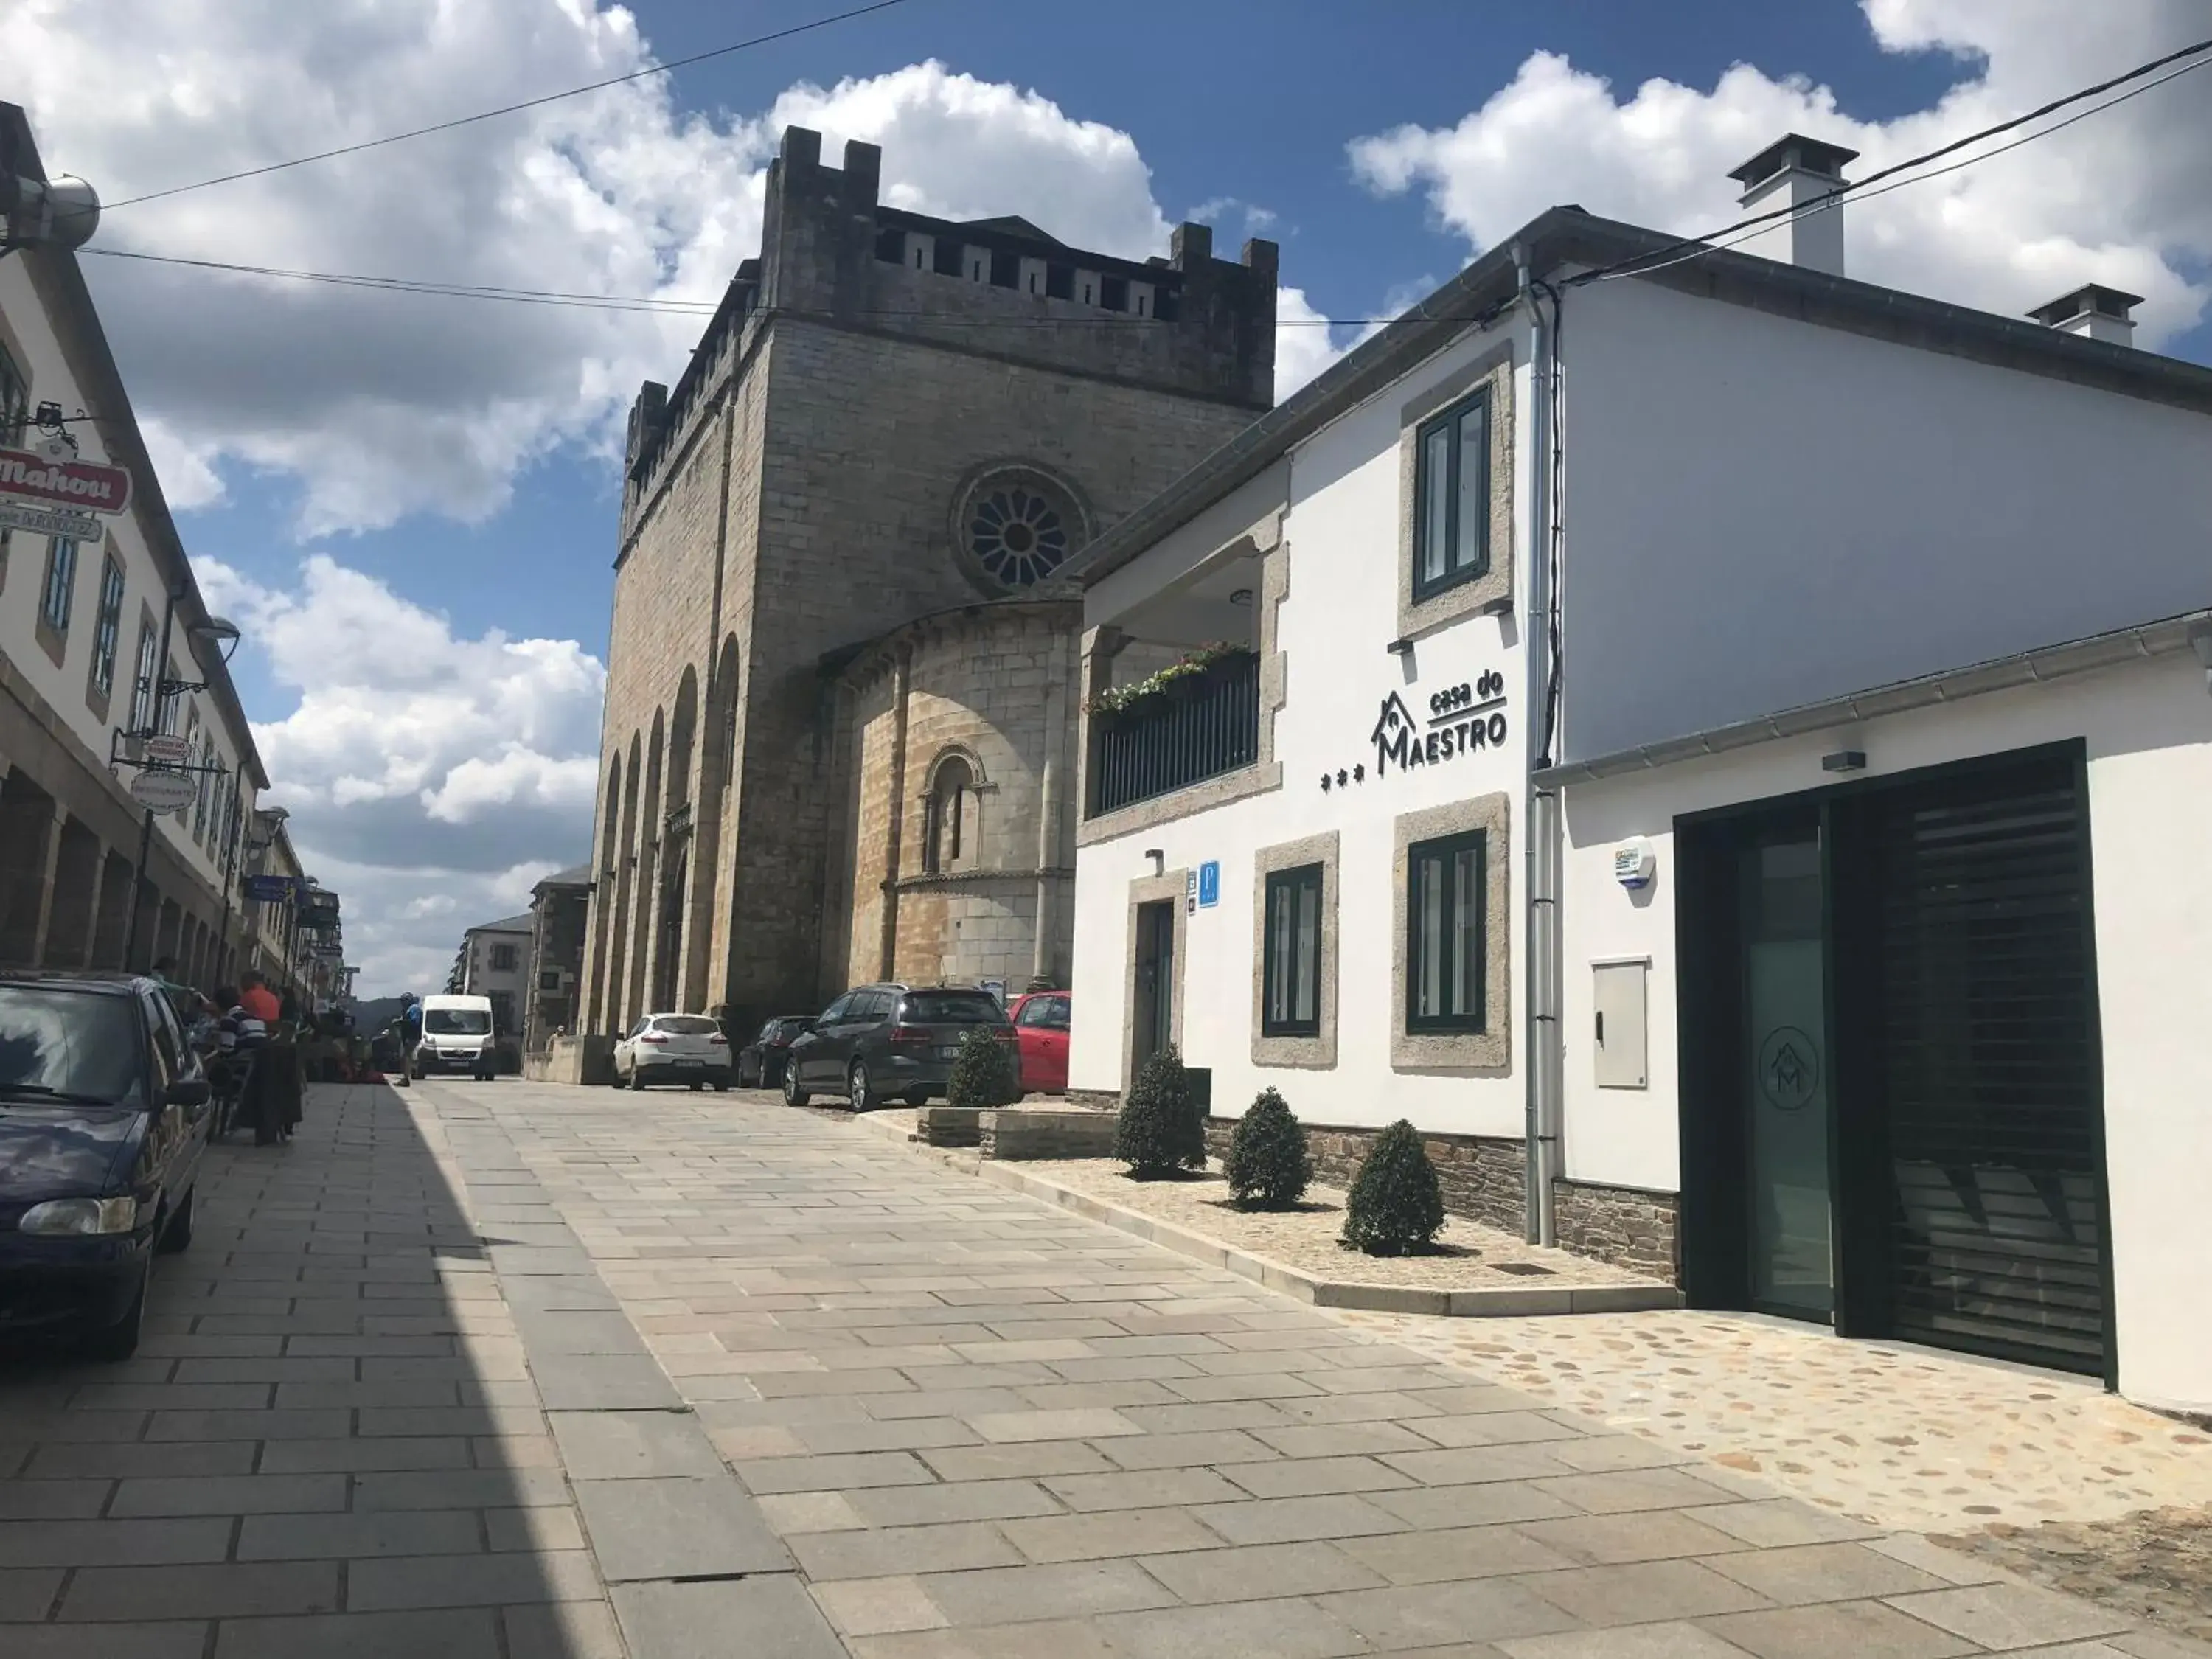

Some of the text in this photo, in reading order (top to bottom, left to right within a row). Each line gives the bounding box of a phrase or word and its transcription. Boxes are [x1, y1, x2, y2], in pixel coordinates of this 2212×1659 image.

[1430, 669, 1503, 714] casa do
[1378, 712, 1508, 776] MAESTRO
[1205, 866, 1214, 890] P
